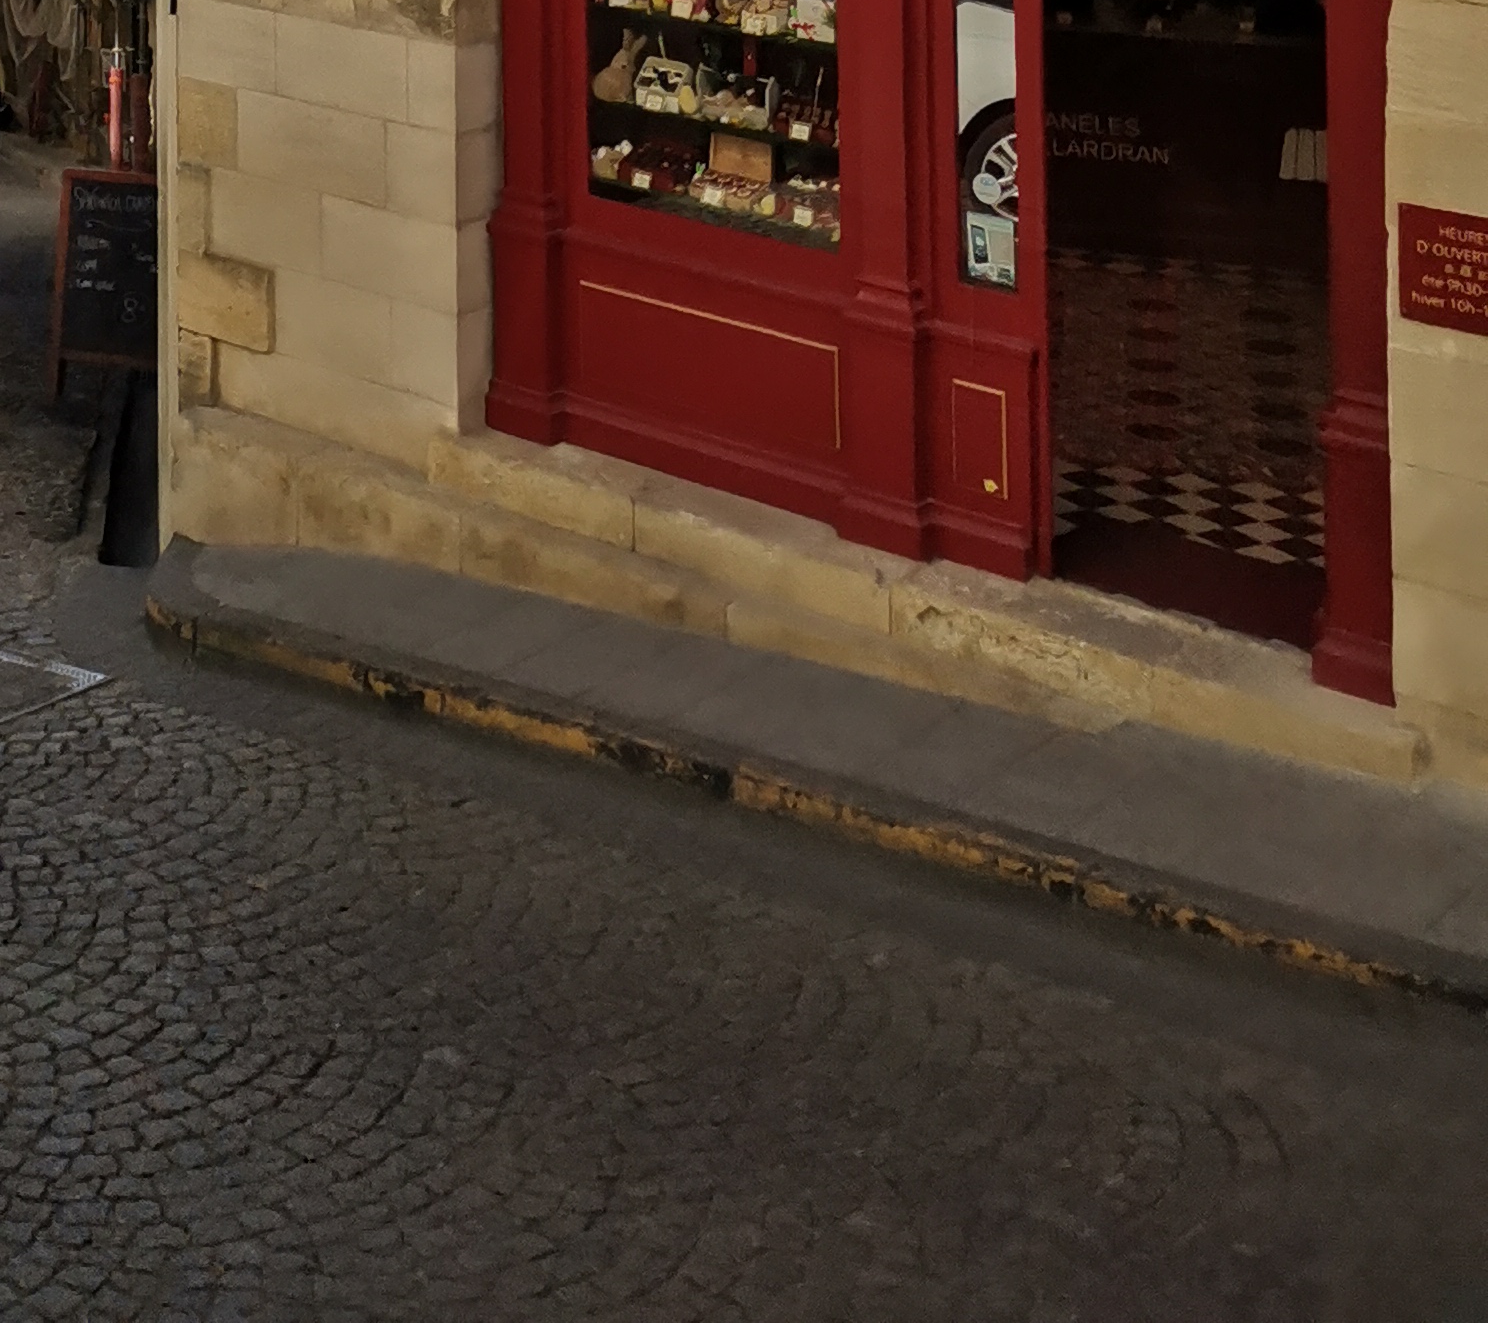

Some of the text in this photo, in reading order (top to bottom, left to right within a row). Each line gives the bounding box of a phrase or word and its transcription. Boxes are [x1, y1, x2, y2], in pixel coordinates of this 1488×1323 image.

[1046, 111, 1141, 137] ANELES
[1047, 137, 1170, 165] LARDRAN
[1438, 226, 1488, 245] HEURE
